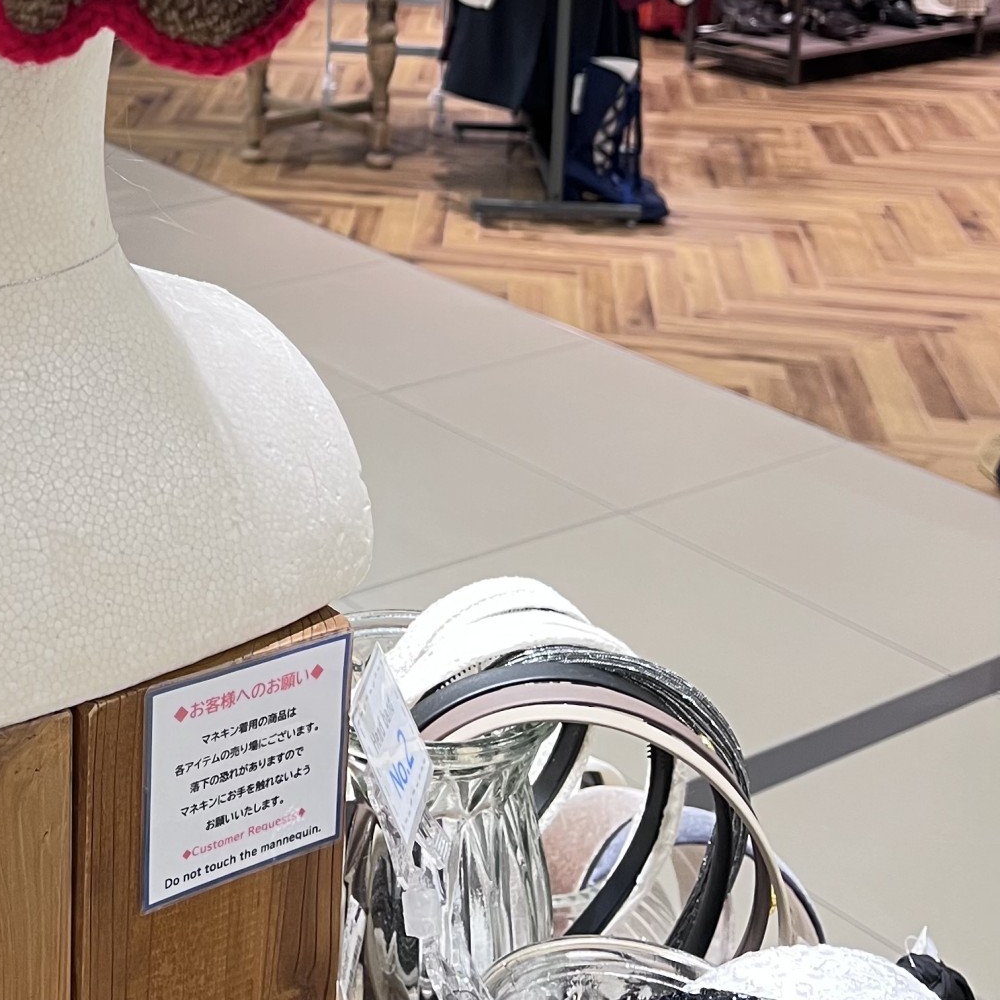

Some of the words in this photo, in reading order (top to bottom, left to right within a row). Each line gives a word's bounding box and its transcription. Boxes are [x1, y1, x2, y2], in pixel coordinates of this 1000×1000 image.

[190, 669, 309, 719] お客様へのお願い
[174, 723, 319, 777] 各アイテムの売り場にございます。
[202, 707, 297, 745] マネキン着用の商品は
[190, 747, 304, 793] 落下の恐れがありますので
[388, 728, 415, 798] No.2
[180, 765, 311, 817] マネキンにお手を触れないよう
[205, 797, 285, 831] お願いいたします。
[165, 877, 180, 890] Do
[183, 869, 202, 883] not
[205, 856, 236, 874] touch
[240, 847, 257, 861] the
[260, 825, 322, 853] mannequin.
[192, 832, 245, 857] Customer
[248, 812, 298, 837] Requests
